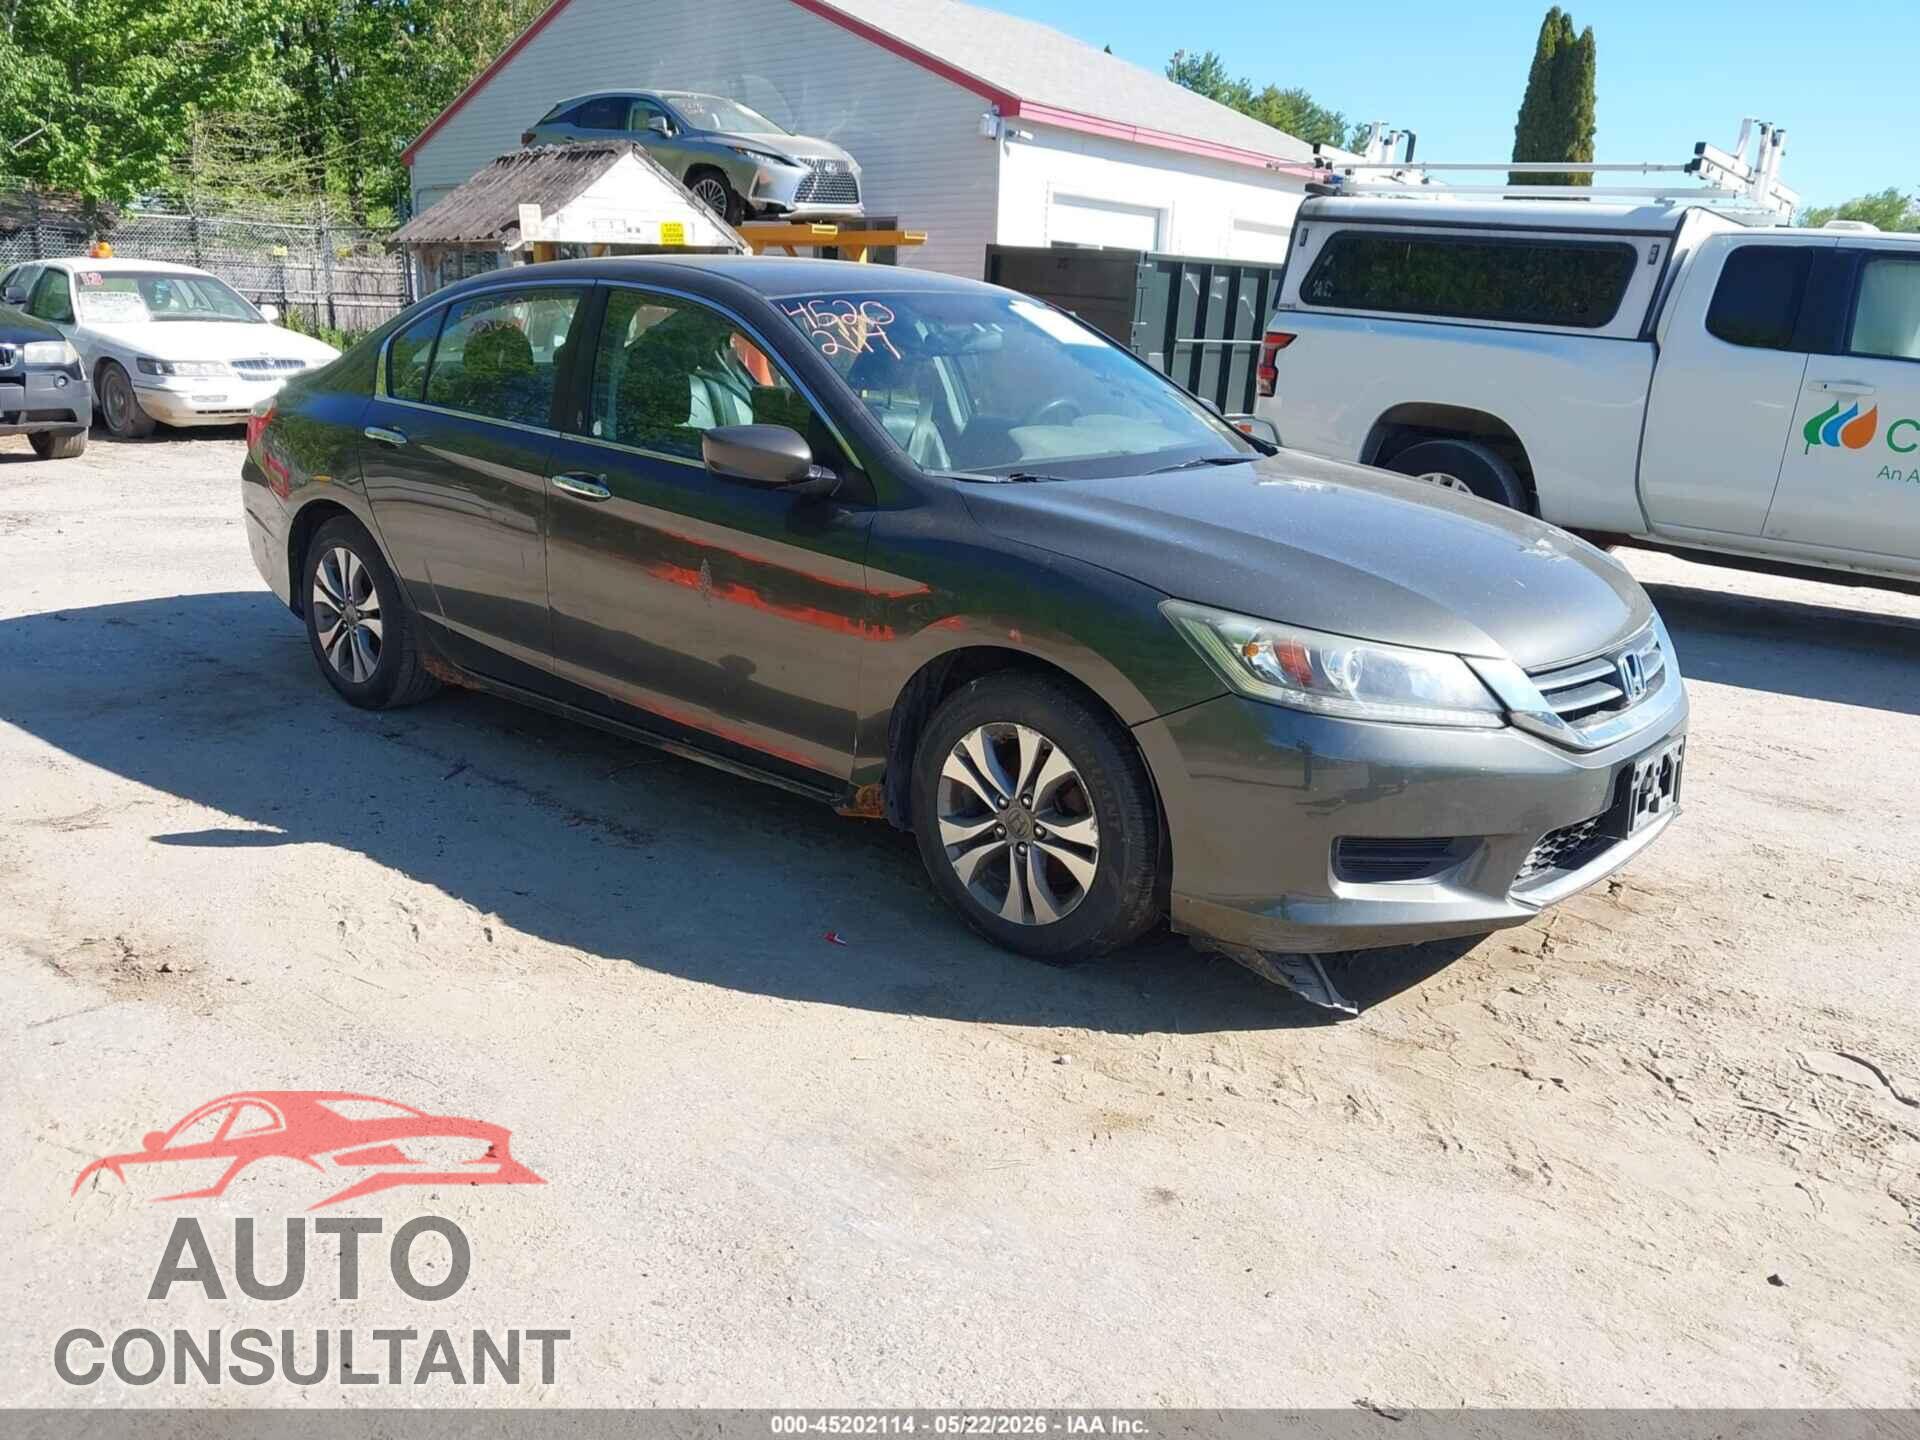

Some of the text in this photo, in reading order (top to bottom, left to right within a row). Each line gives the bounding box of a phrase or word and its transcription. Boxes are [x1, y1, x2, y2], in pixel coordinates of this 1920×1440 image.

[780, 299, 895, 329] 4520
[1886, 418, 1920, 453] C
[1876, 465, 1903, 480] An
